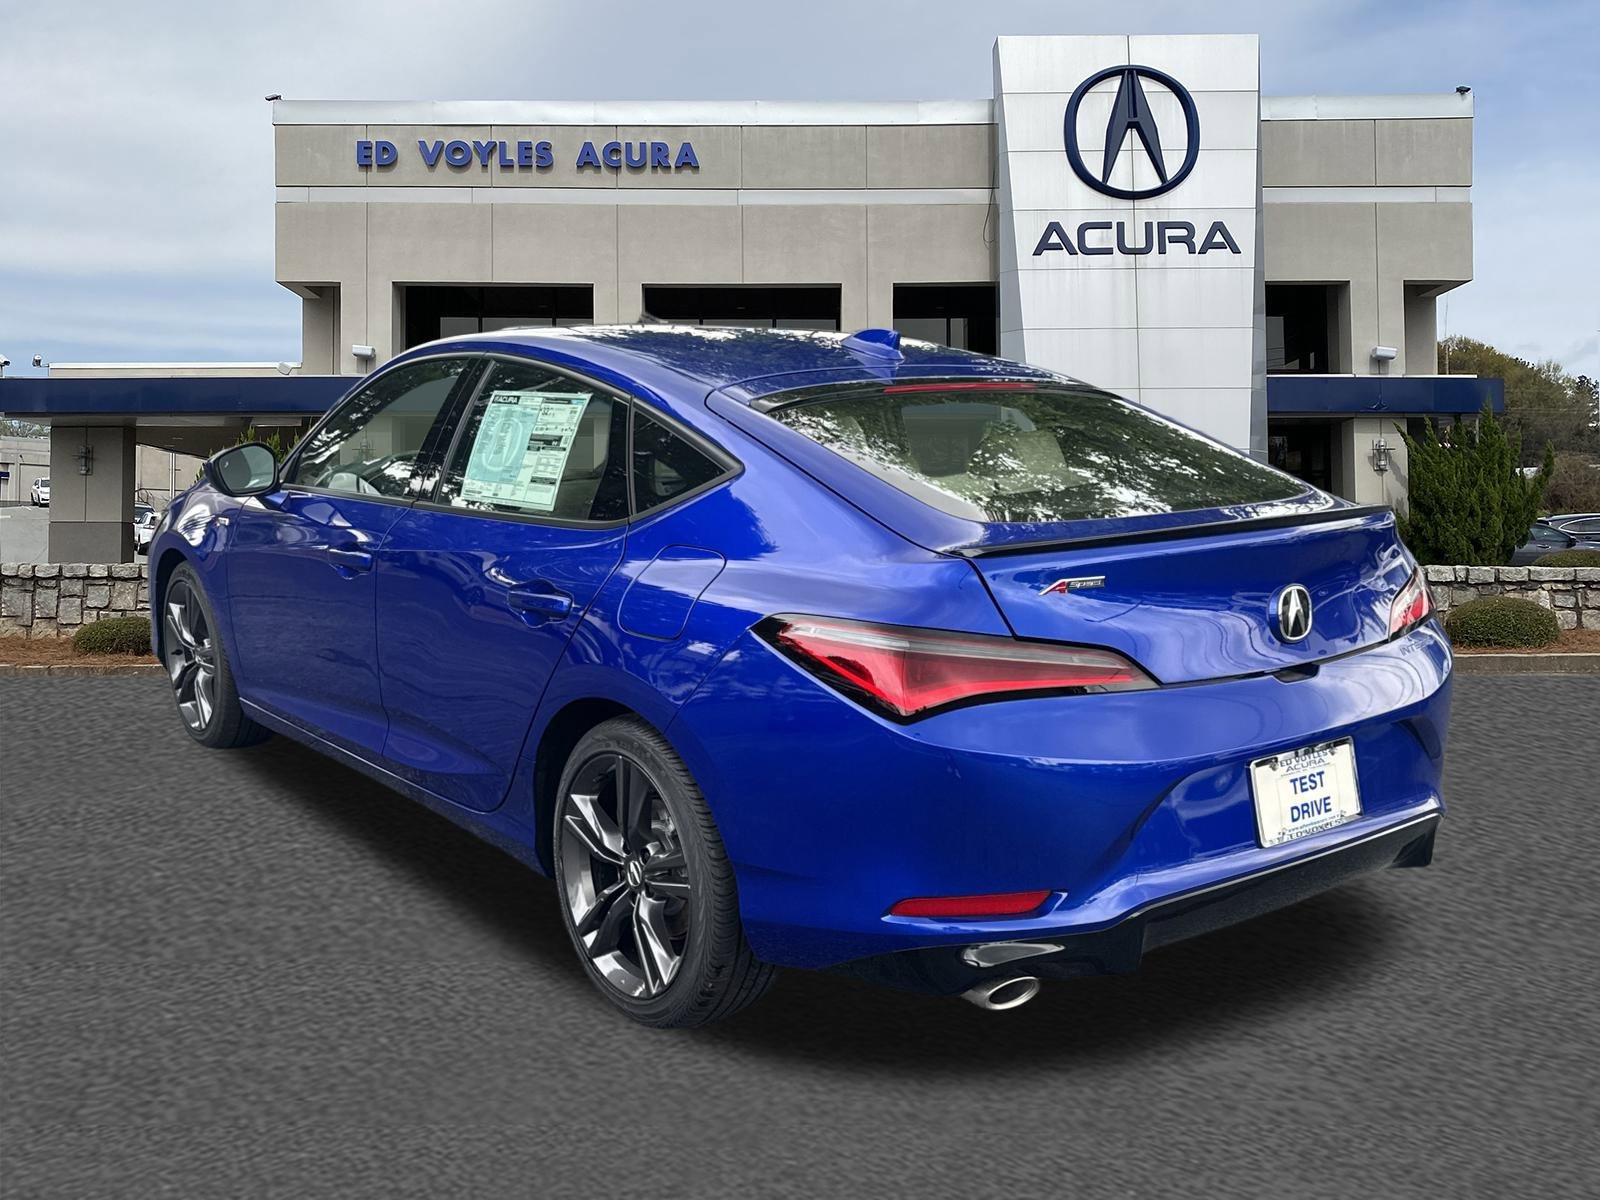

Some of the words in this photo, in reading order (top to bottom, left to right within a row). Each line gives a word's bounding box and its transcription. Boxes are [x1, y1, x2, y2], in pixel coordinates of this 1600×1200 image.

[356, 140, 398, 168] ED
[417, 140, 554, 168] VOYLES
[576, 141, 700, 168] ACURA
[1032, 221, 1242, 256] ACURA
[1286, 758, 1326, 772] ACURA
[1290, 770, 1325, 795] TEST
[1290, 796, 1332, 822] DRIVE
